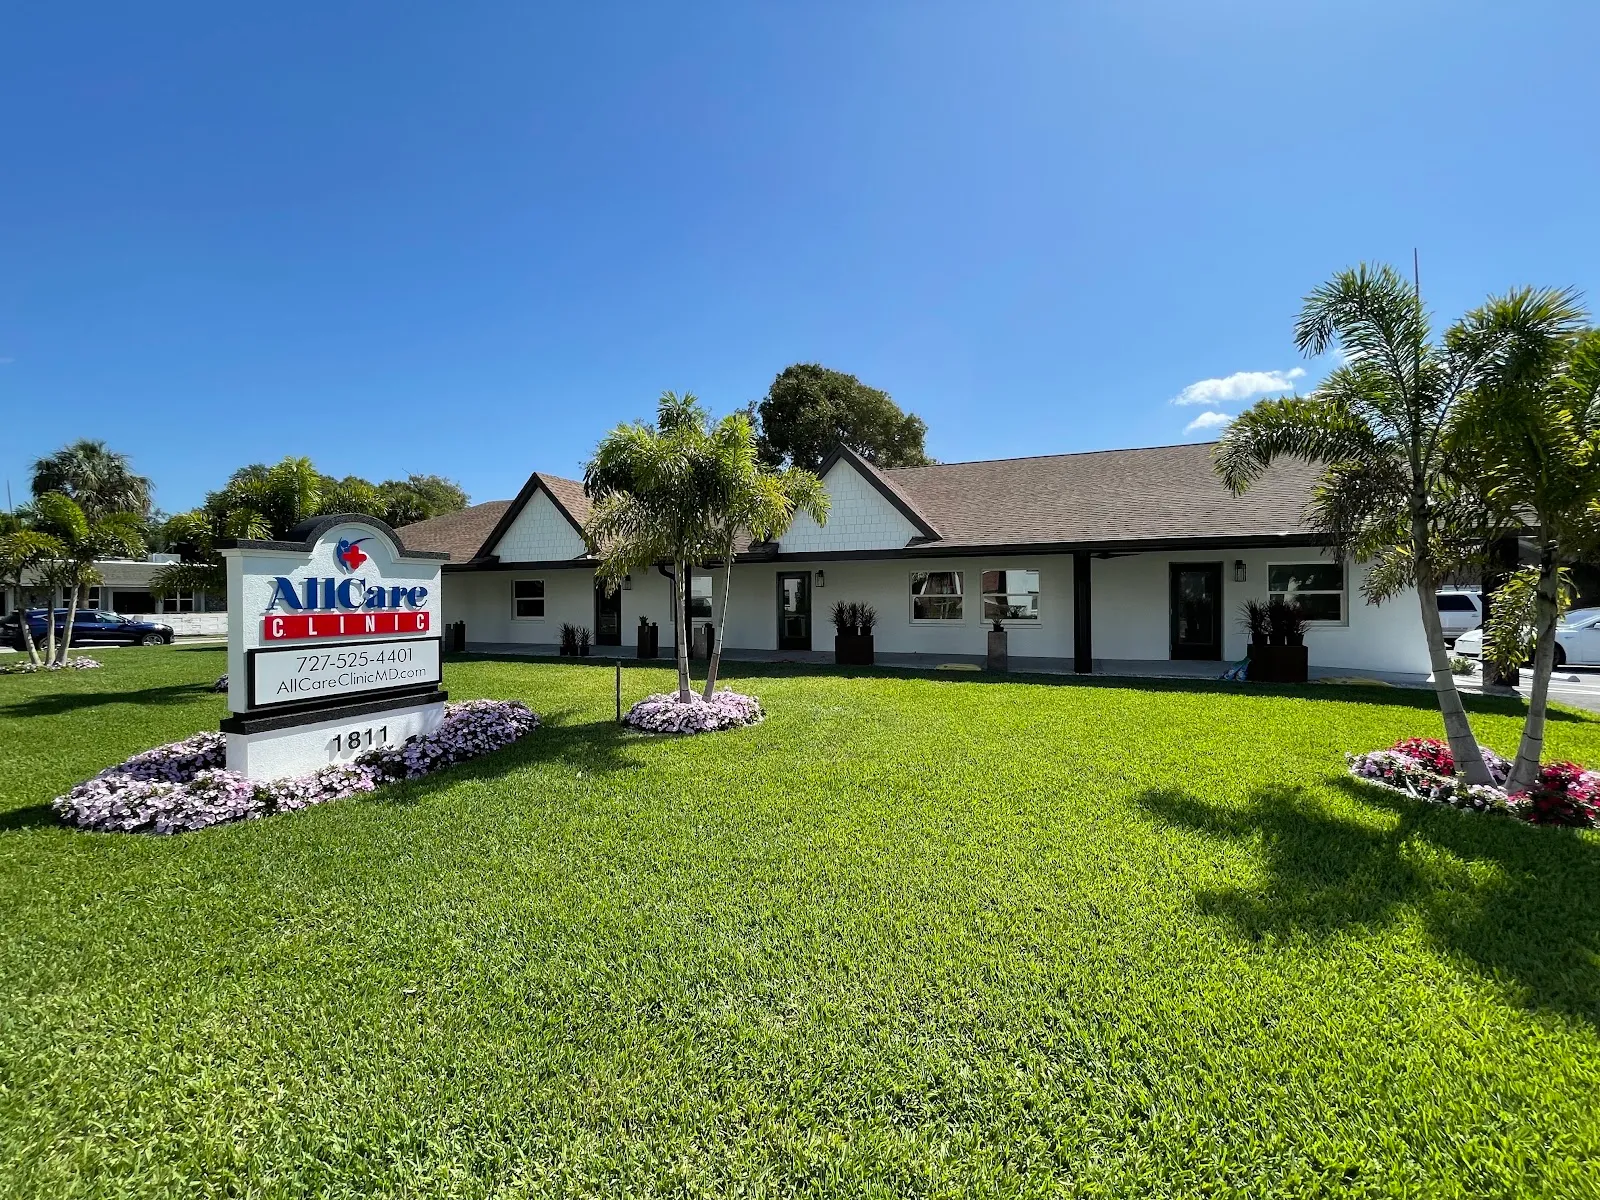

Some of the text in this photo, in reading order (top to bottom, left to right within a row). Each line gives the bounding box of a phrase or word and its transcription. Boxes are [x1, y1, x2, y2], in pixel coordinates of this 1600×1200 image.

[265, 576, 428, 610] AllCare
[272, 613, 425, 638] CLINIC
[296, 648, 413, 673] 727-525-4401
[276, 667, 427, 695] AllCareClinicMD.com
[332, 725, 388, 751] 1811
